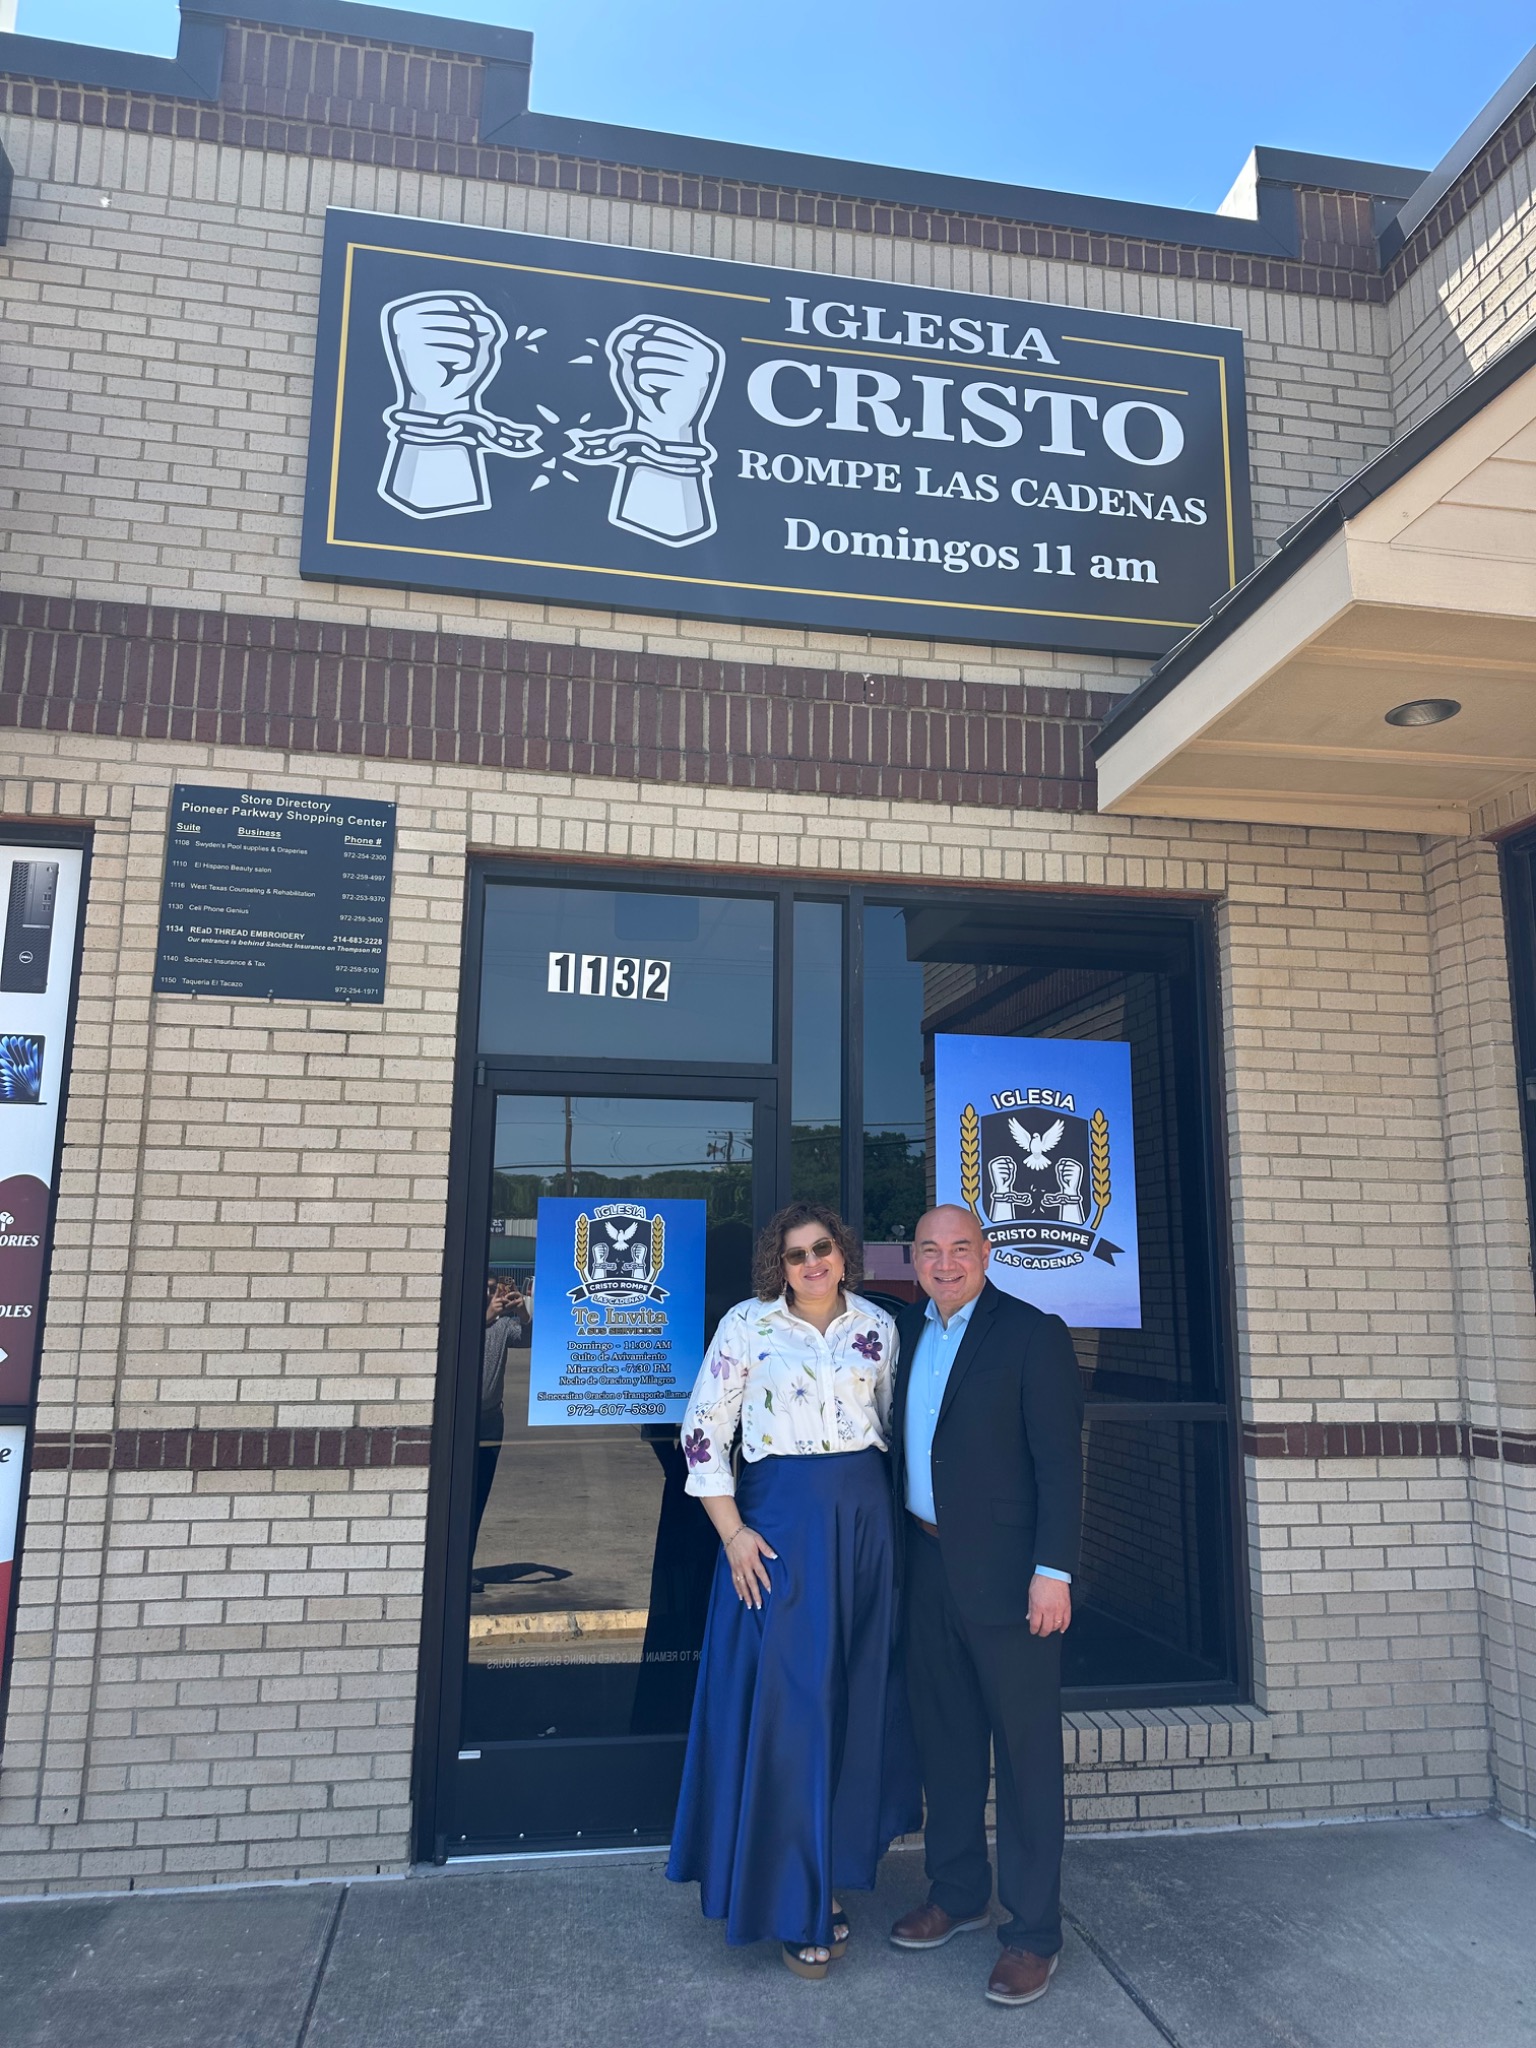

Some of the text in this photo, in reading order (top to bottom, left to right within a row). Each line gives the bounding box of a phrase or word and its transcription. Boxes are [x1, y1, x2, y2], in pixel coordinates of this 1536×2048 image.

[785, 296, 1060, 365] IGLESIA
[747, 359, 1184, 466] CRISTO
[738, 449, 1208, 525] ROMPE LAS CADENAS
[784, 517, 1159, 583] Domingos 11 am
[240, 794, 331, 812] Store Directory
[182, 802, 388, 828] Pioneer Parkway Shopping Center
[176, 822, 382, 847] Suite Business Phone #
[203, 863, 230, 871] Hispano
[230, 865, 253, 873] Beauty
[228, 886, 265, 895] Counseling
[272, 888, 316, 898] Rehabilitation
[214, 928, 248, 937] THREAD
[250, 930, 306, 940] EMBROIDERY
[294, 943, 326, 951] Insurance
[337, 946, 370, 954] Thompson
[184, 956, 212, 964] Sanchez
[214, 958, 246, 966] Insurance
[182, 978, 210, 986] Taqueria
[555, 954, 667, 1000] 1132
[990, 1087, 1076, 1112] IGLESIA
[594, 1204, 646, 1218] IGLESIA
[987, 1228, 1090, 1246] CRISTO ROMPE
[994, 1250, 1084, 1270] LAS CADENAS
[589, 1282, 649, 1292] CRISTO ROMPE
[592, 1294, 646, 1306] LAS CADENAS
[571, 1306, 668, 1326] Te Invita
[577, 1327, 586, 1336] A
[568, 1341, 614, 1352] Domingo
[624, 1340, 652, 1350] 11:00
[654, 1340, 672, 1350] AM
[571, 1352, 668, 1361] Culto de Avivamiento
[566, 1364, 620, 1374] Miercoles
[652, 1363, 672, 1373] PM
[559, 1374, 676, 1386] Noche de Oracion y Milagros
[584, 1391, 616, 1400] Oracion
[622, 1390, 664, 1400] Transporte
[567, 1403, 666, 1416] 972-607-5890
